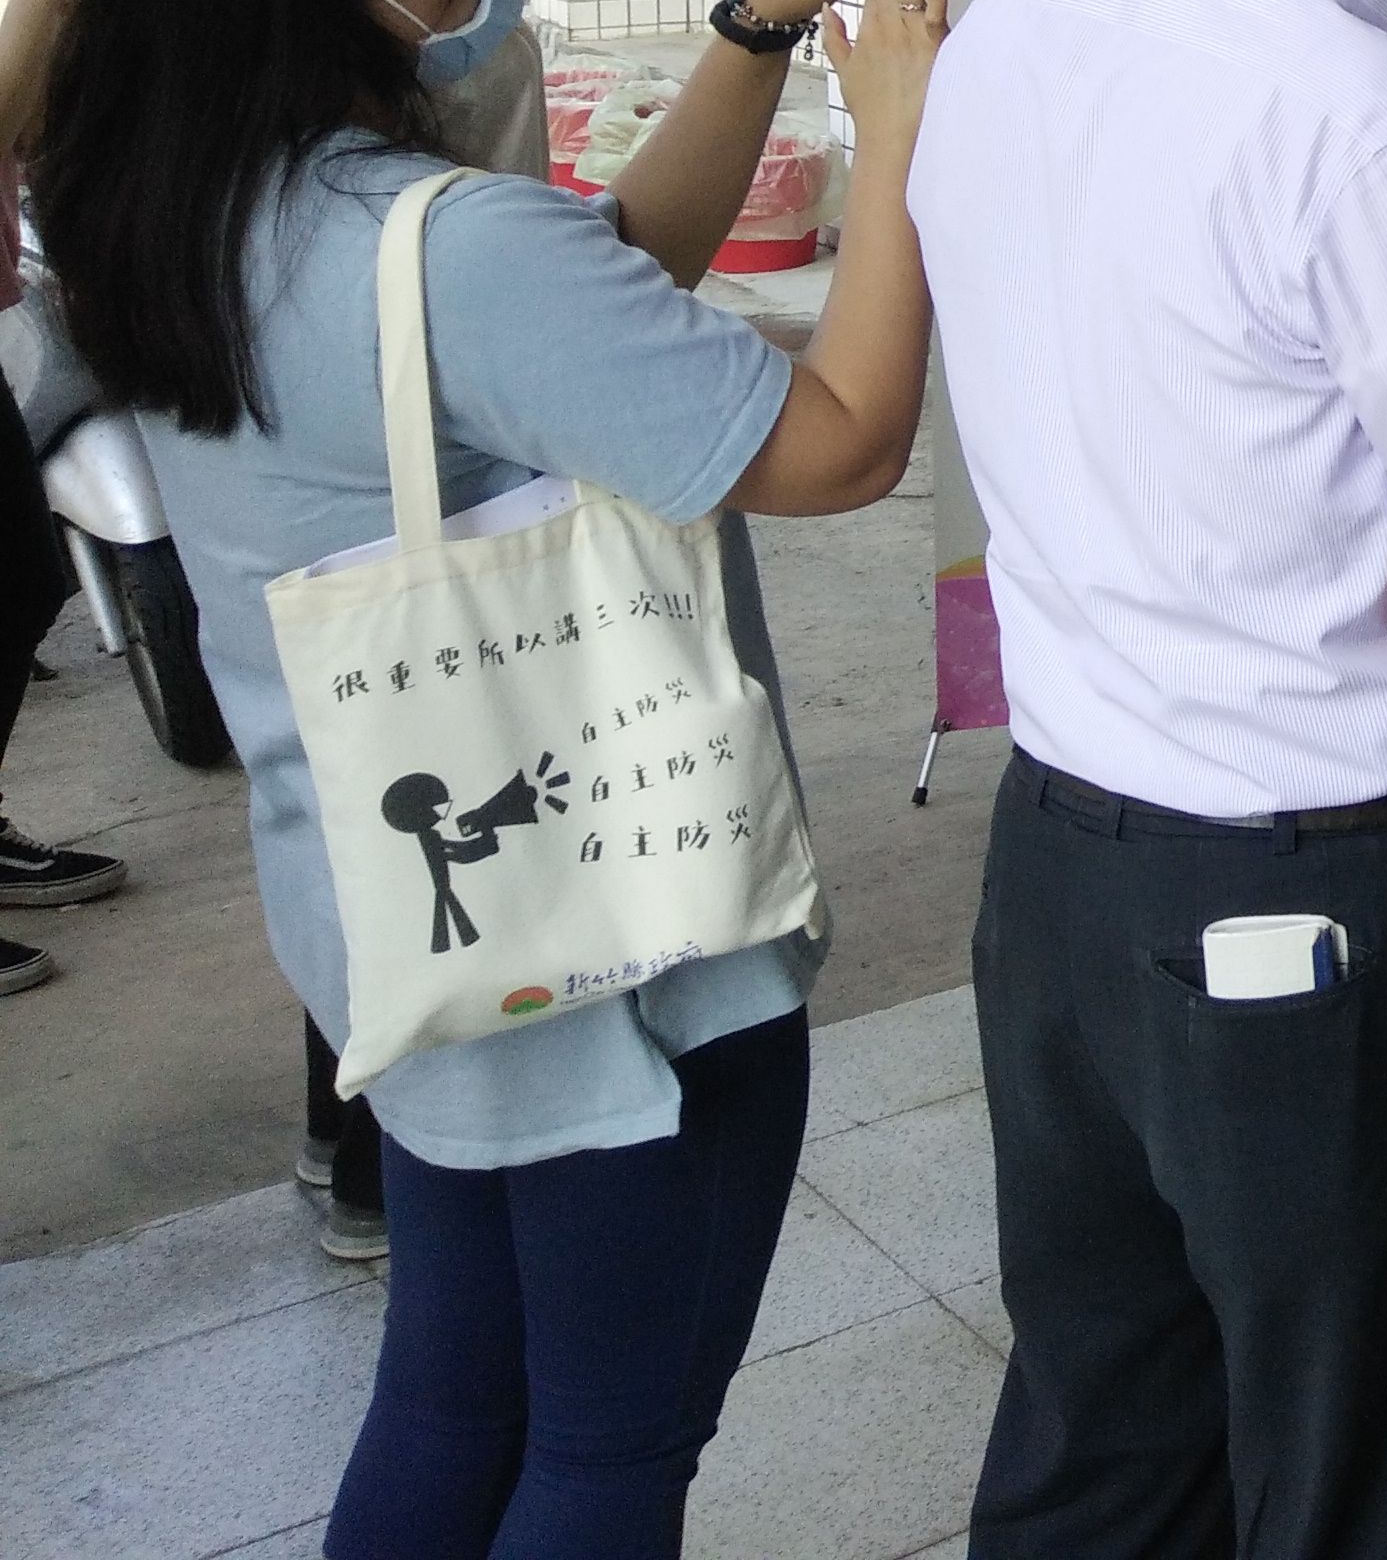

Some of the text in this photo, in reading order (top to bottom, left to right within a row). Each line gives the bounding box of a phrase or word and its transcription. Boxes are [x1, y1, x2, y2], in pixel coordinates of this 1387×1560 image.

[580, 676, 692, 744] 自主防災
[590, 732, 735, 804] 自主防災
[579, 803, 752, 864] 自主防災
